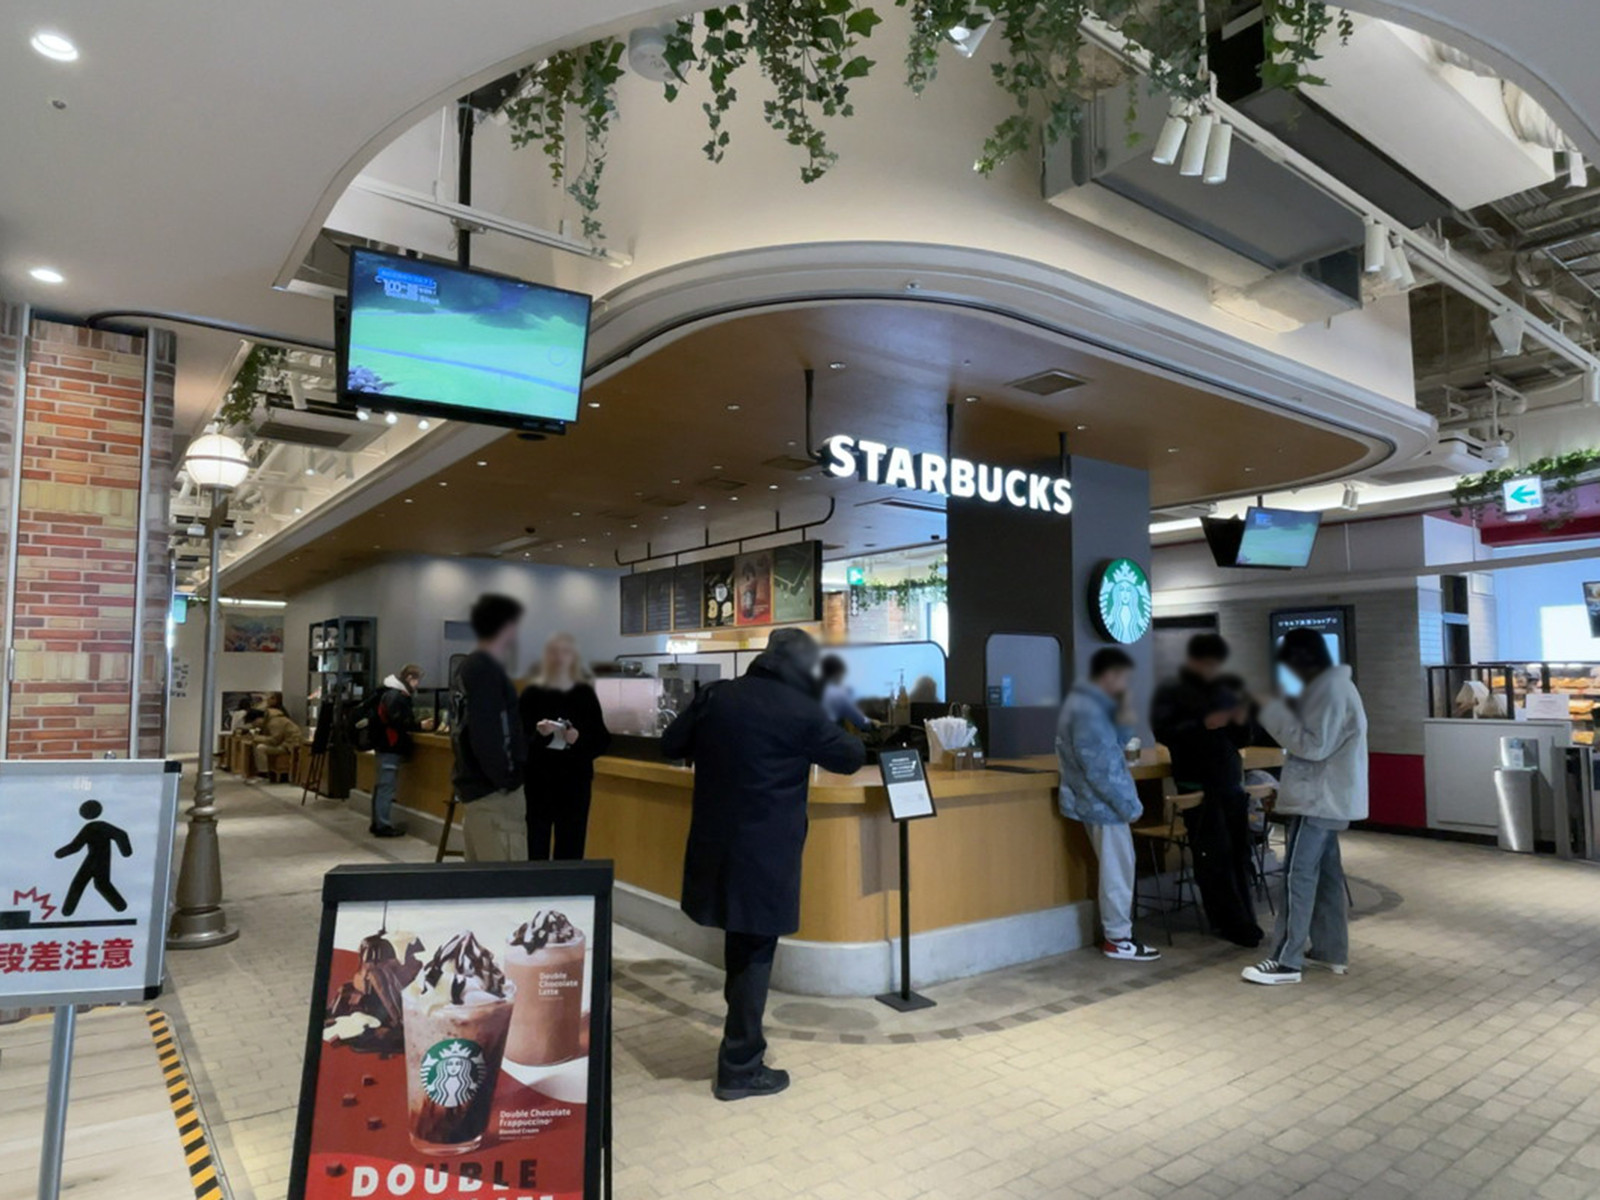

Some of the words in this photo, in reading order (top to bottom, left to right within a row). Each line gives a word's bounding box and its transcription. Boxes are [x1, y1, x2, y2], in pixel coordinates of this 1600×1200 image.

[828, 434, 1073, 514] STARBUCKS
[0, 938, 134, 974] 段差注意
[539, 972, 567, 980] Double
[539, 980, 578, 988] Chocolate
[538, 988, 559, 996] Latte
[500, 1110, 528, 1118] Double
[530, 1108, 571, 1117] Chocolate
[351, 1159, 537, 1197] DOUBLE
